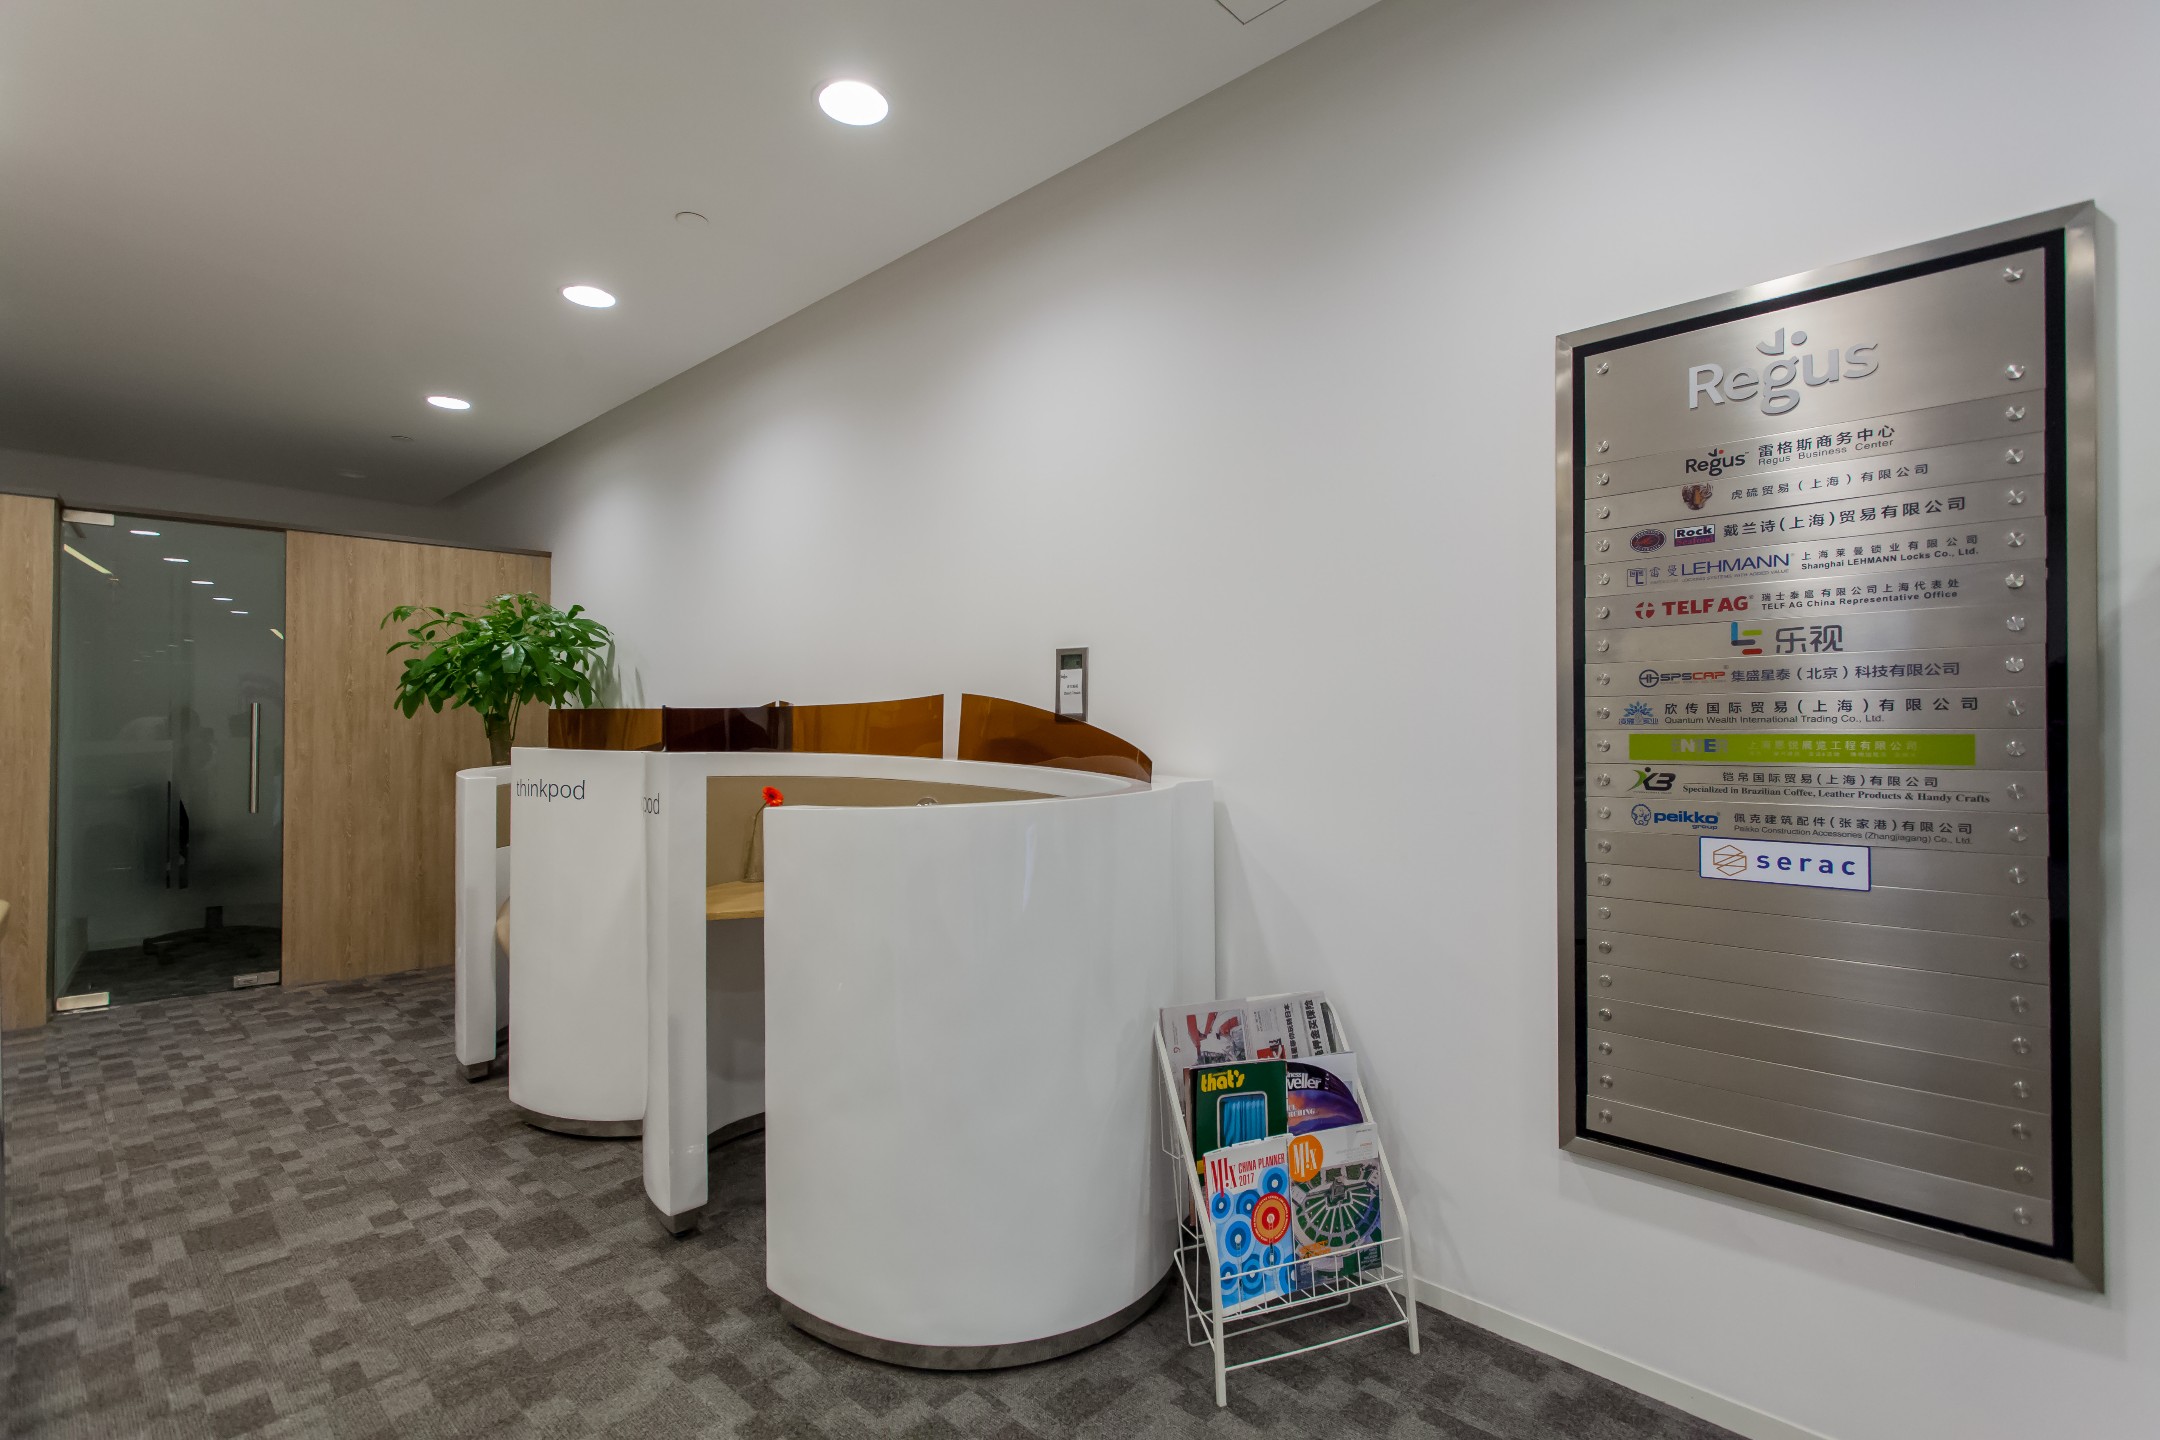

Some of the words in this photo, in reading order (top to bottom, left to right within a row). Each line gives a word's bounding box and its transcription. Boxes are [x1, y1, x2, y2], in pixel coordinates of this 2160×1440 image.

[1688, 343, 1879, 416] Regus
[1758, 425, 1895, 458] 雷格斯商务中心
[1758, 454, 1791, 466] Regus
[1798, 446, 1847, 460] Business
[1855, 439, 1894, 451] Center
[1685, 450, 1746, 477] Regus
[1677, 525, 1713, 538] Rock
[1681, 553, 1790, 576] LEHMANN
[1801, 559, 1844, 570] Shanghai
[1847, 554, 1897, 566] LEHMANN
[1900, 551, 1931, 561] Locks
[1958, 547, 1979, 557] Ltd.
[1662, 598, 1715, 616] TELF
[1717, 595, 1748, 613] AG
[1762, 602, 1786, 611] TELF
[1788, 601, 1804, 609] AG
[1806, 598, 1836, 608] China
[1839, 593, 1920, 606] Representative
[1923, 589, 1958, 600] Office
[1775, 624, 1844, 654] 乐视
[1660, 671, 1726, 682] SPSCAP
[1731, 662, 1960, 683] 集盛星泰（北京）科技有限公司
[1664, 697, 1978, 715] 欣传国际贸易（上海）有限公司
[1664, 716, 1704, 724] Quantum
[1706, 716, 1737, 724] Wealth
[1740, 715, 1798, 723] International
[1801, 714, 1838, 725] Trading
[1841, 715, 1862, 724] Co.,
[1866, 714, 1885, 722] Ltd.
[517, 779, 585, 802] thinkpod
[1682, 785, 1733, 795] Specialized
[1741, 785, 1781, 796] Brazilian
[1784, 788, 1816, 798] Coffee,
[1818, 789, 1855, 799] Leather
[1858, 790, 1902, 800] Products
[1904, 792, 1914, 800] &
[1918, 793, 1952, 804] Handy
[1956, 794, 1991, 803] Crafts
[1654, 811, 1719, 825] peikko
[1734, 812, 1973, 835] 佩克建筑配件（张家港）有限公司
[1734, 825, 1760, 833] Peikko
[1761, 826, 1811, 835] Construction
[1812, 829, 1863, 839] Accessories
[1865, 832, 1931, 844] (Zhangjiagang)
[1756, 855, 1856, 876] serac
[1201, 1070, 1245, 1093] that's
[1238, 1158, 1258, 1174] CHINA
[1258, 1152, 1286, 1169] PLANNER
[1239, 1172, 1255, 1187] 2017
